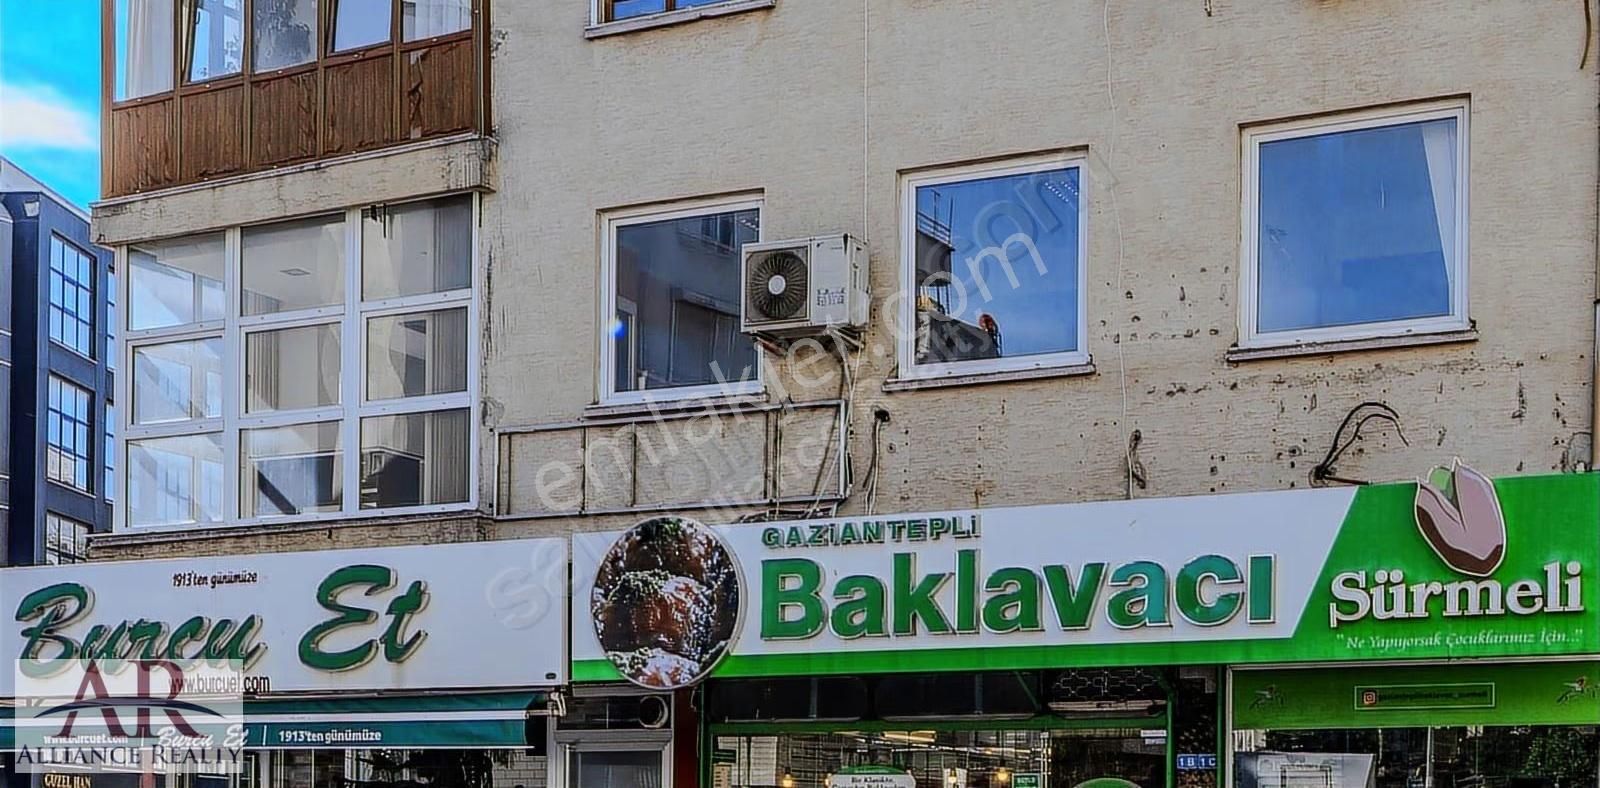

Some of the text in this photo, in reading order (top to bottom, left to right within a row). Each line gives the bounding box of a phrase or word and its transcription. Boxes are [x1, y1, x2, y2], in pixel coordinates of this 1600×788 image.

[172, 570, 258, 590] 1913'ten günümüze
[760, 547, 1276, 642] Baklavacı
[1329, 560, 1585, 628] Sürmeli
[14, 563, 430, 679] Burcu Et
[278, 729, 324, 742] 1913'ten
[325, 729, 383, 744] günümüze
